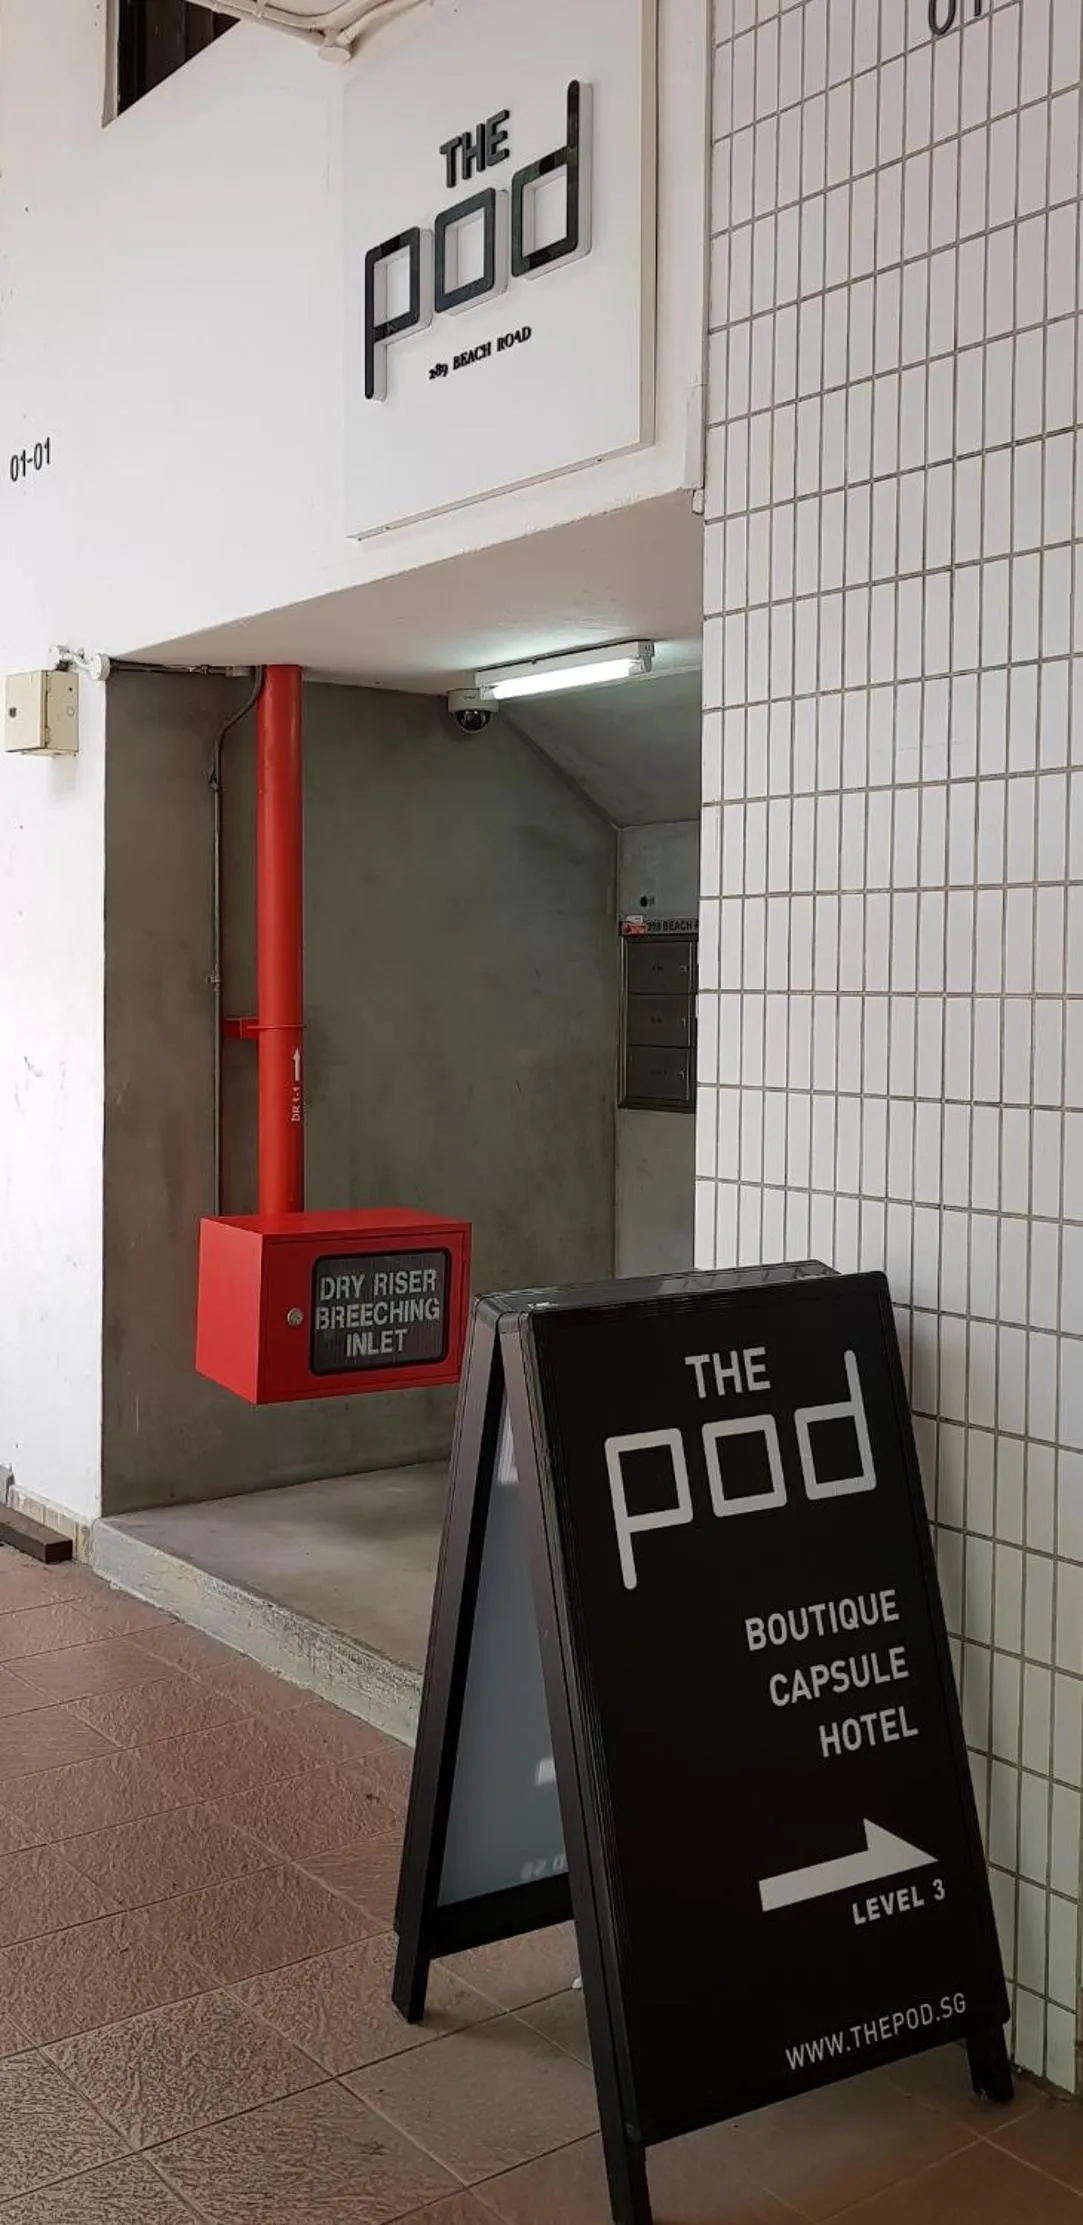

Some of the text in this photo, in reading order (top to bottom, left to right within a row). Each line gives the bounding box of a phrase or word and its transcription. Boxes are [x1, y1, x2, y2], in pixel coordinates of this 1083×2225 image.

[440, 109, 510, 188] THE
[365, 80, 582, 400] pod
[428, 326, 532, 380] 289 BEACH ROAD
[10, 436, 50, 483] 01-01
[662, 919, 692, 931] BEACH
[320, 1269, 437, 1301] DRY RISER
[315, 1297, 440, 1330] BREECHING
[345, 1329, 408, 1357] INLET
[685, 1346, 771, 1399] THE
[604, 1349, 877, 1590] pod
[744, 1589, 900, 1651] BOUTIQUE
[769, 1646, 911, 1708] CAPSULE
[818, 1704, 919, 1759] HOTEL
[851, 1878, 946, 1925] LEVEL 3
[785, 1993, 968, 2071] WWW.THEPOD.SG
